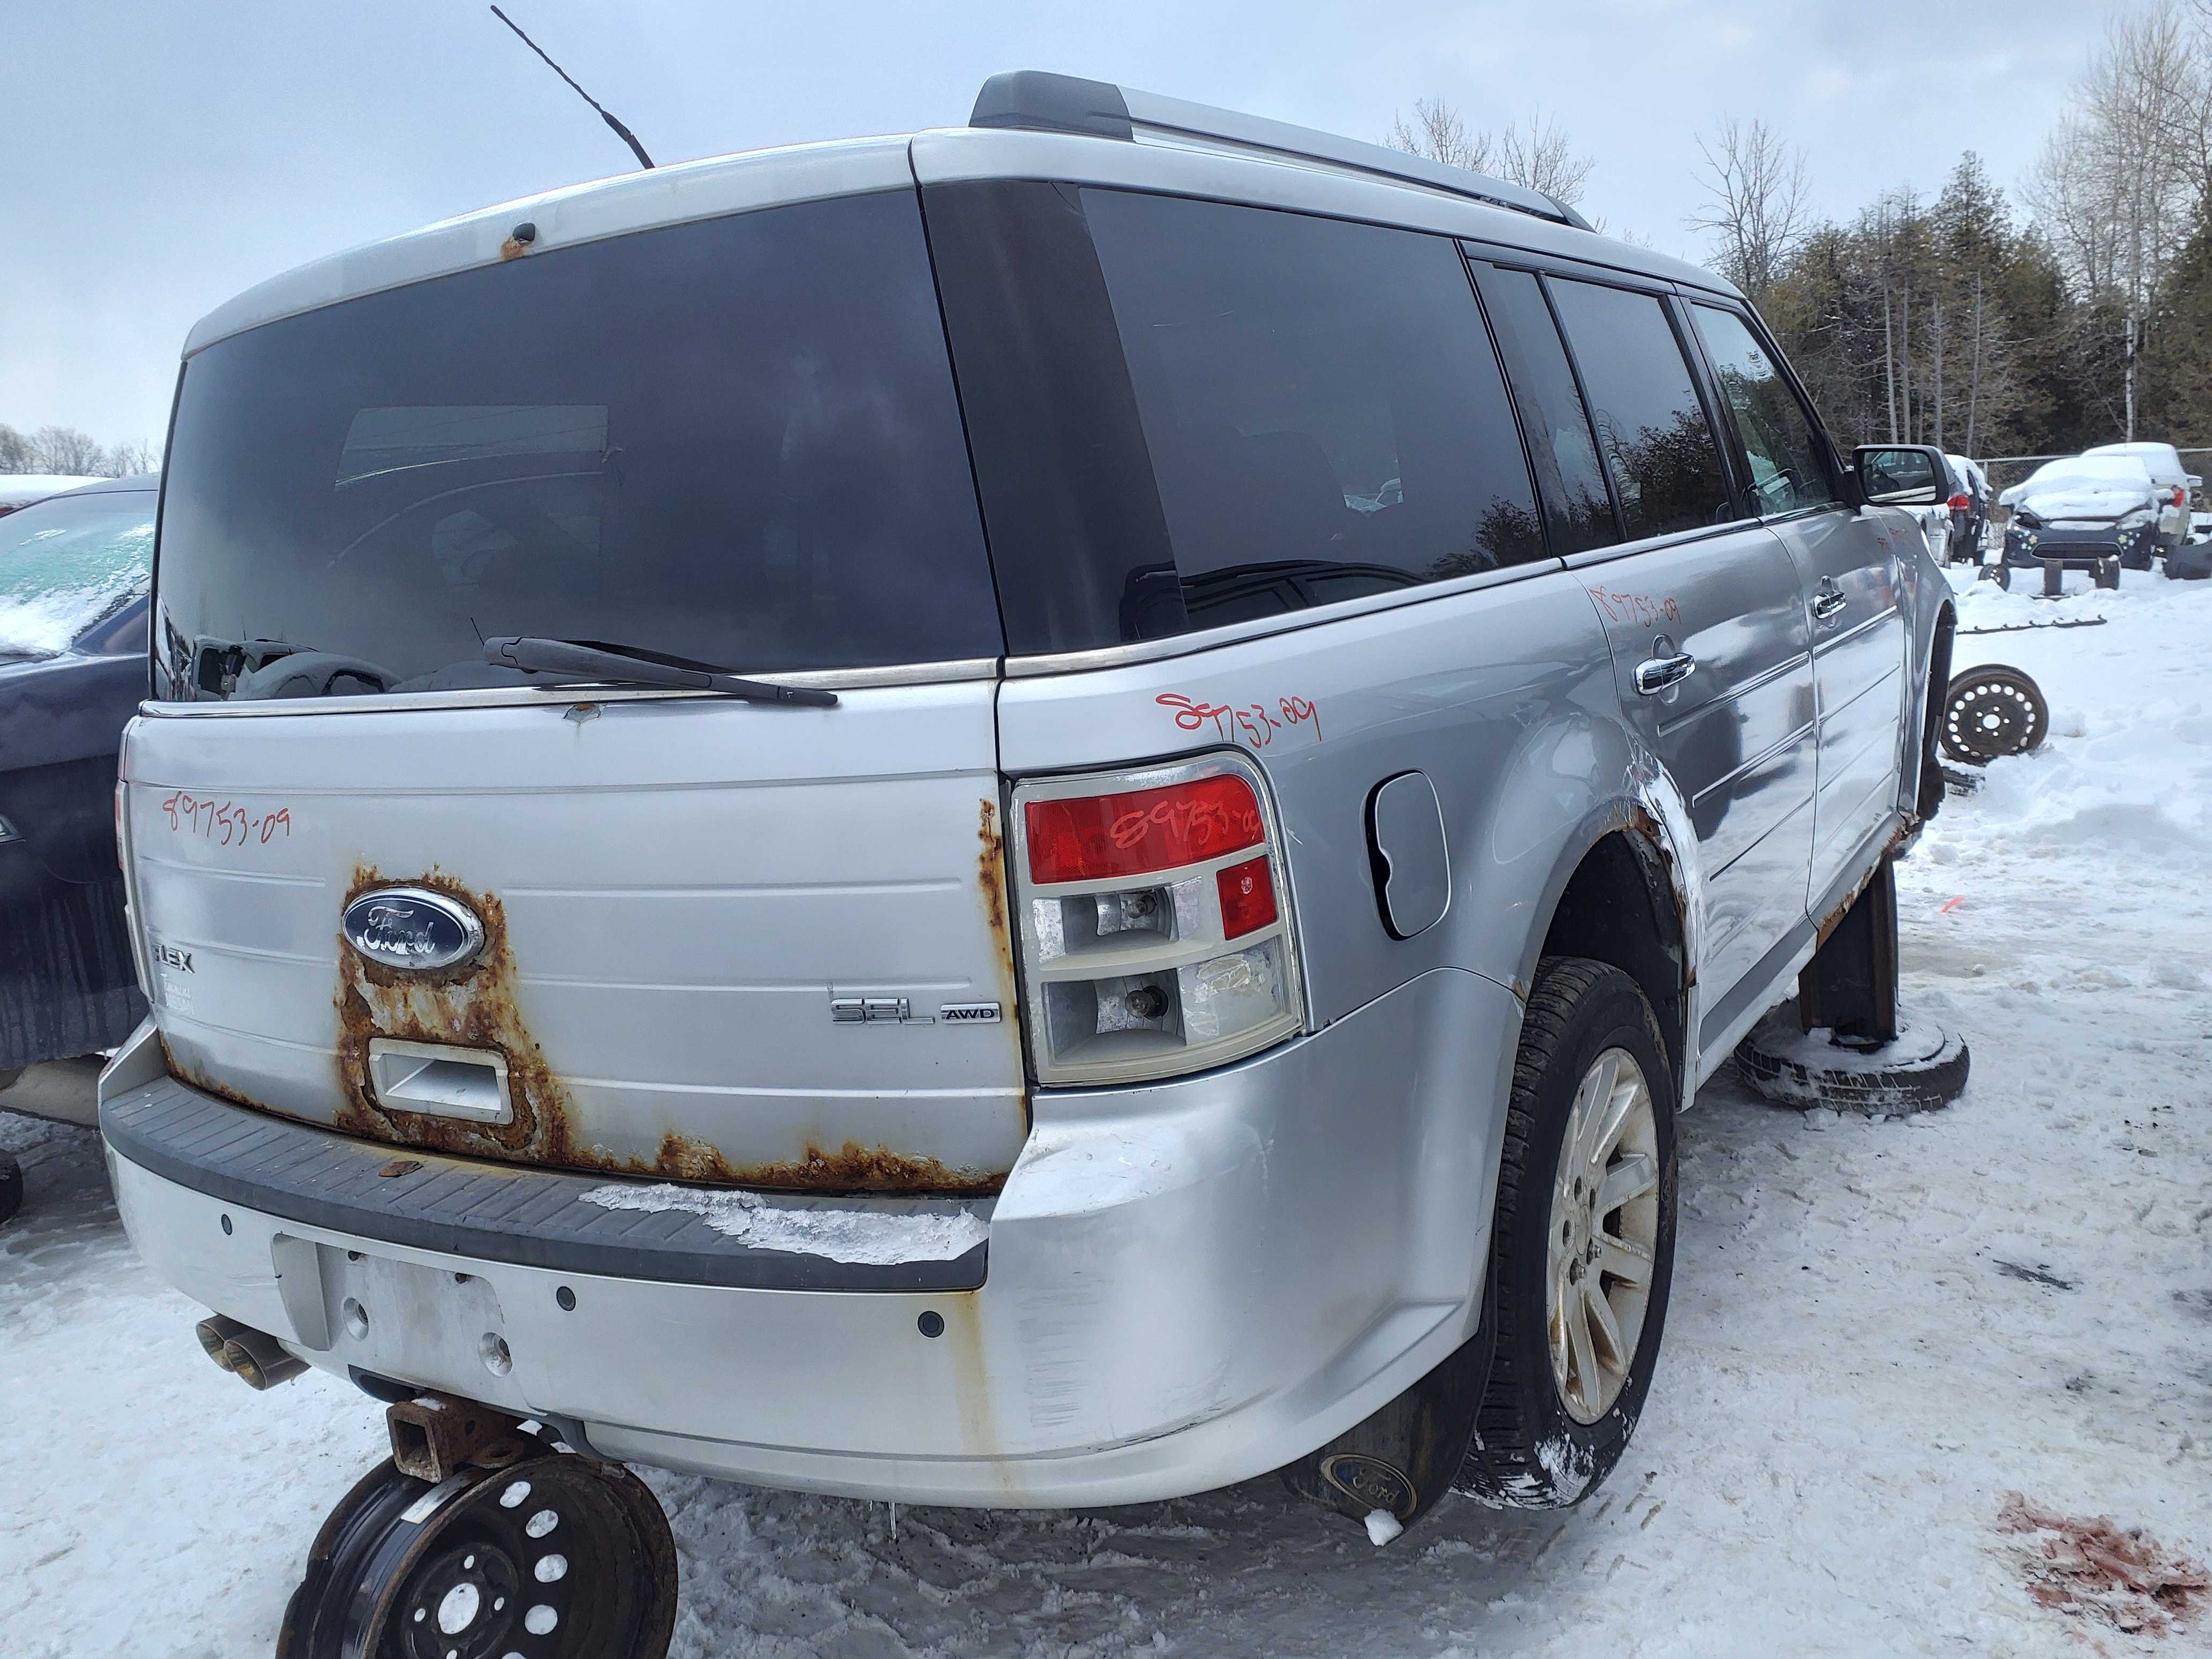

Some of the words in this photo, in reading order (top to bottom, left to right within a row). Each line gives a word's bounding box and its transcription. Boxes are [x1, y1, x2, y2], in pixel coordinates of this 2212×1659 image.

[1589, 585, 1682, 627] 89753-09
[162, 791, 290, 846] 89753-09
[363, 906, 436, 955] Ford
[831, 998, 936, 1025] SEL
[945, 1007, 996, 1020] AWD
